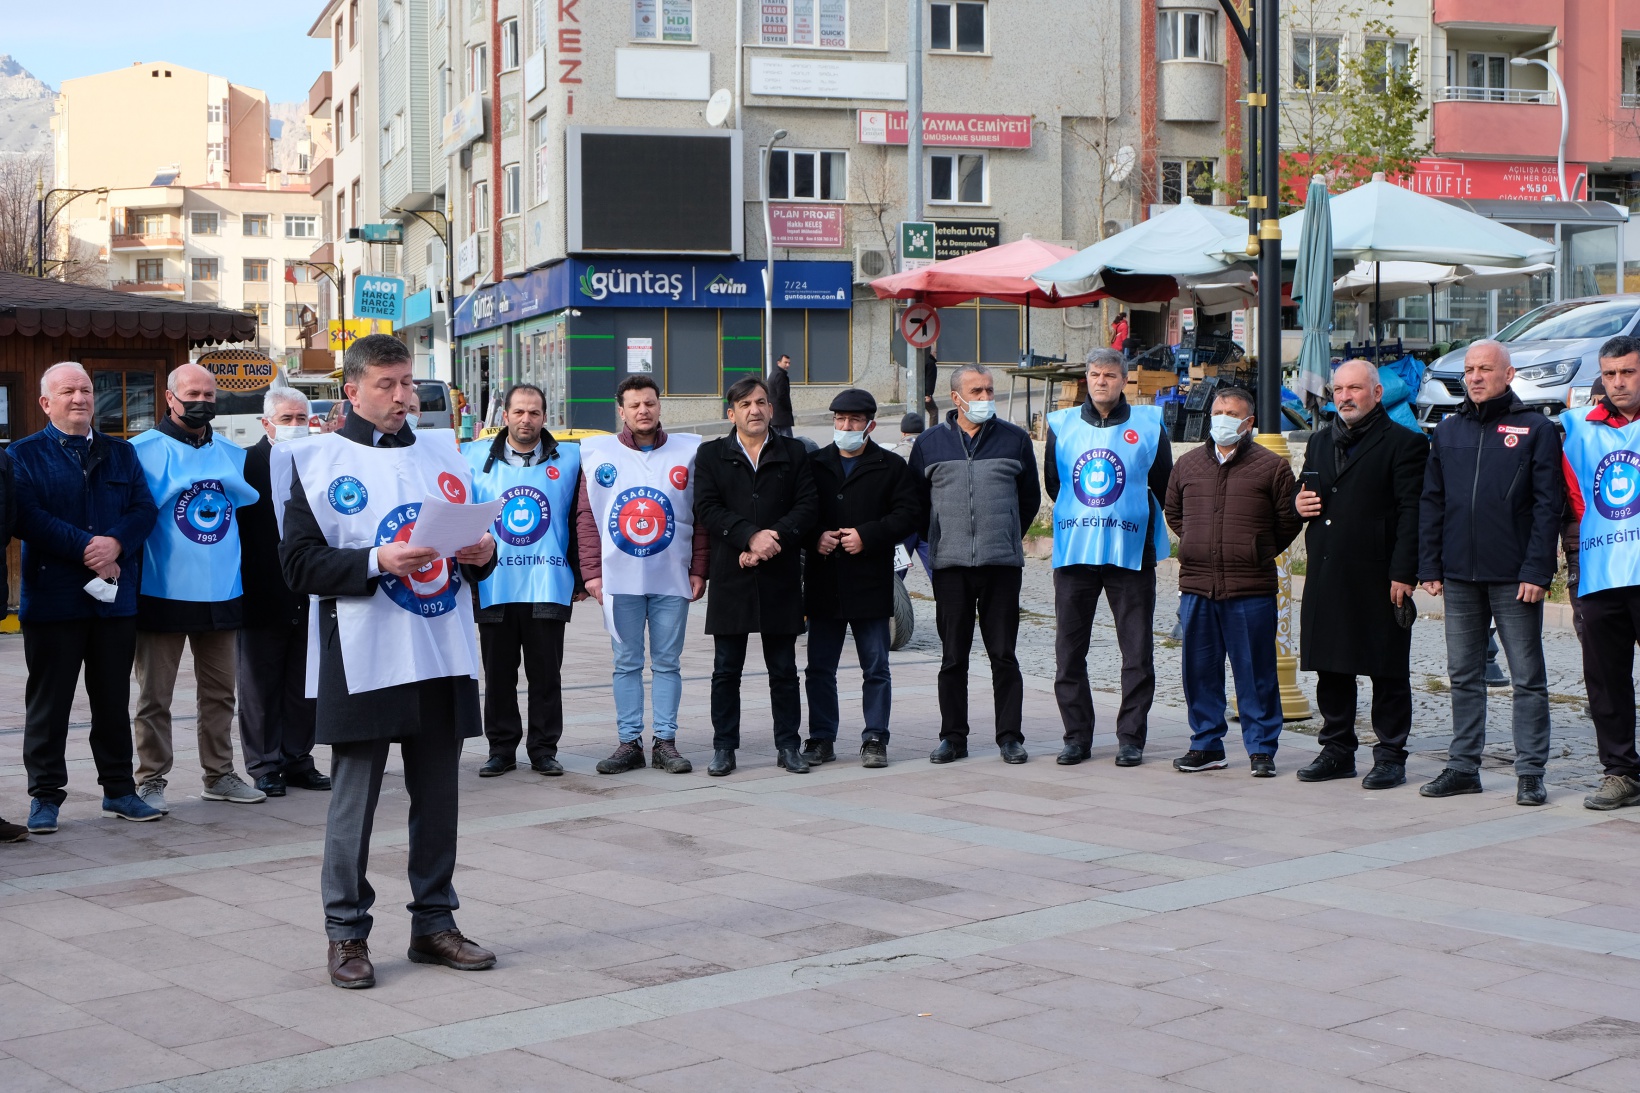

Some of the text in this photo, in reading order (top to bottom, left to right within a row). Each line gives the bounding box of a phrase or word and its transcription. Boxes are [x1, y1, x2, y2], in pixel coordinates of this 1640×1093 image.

[667, 16, 689, 25] HDI
[820, 38, 845, 46] ERGO
[922, 118, 964, 131] YAYMA
[968, 118, 1027, 132] CEMİYETİ
[970, 134, 999, 143] ŞUBESİ
[1509, 166, 1539, 174] AÇILIŞA
[1519, 184, 1547, 193] +%50
[773, 210, 836, 219] PLAN PROJE
[970, 227, 996, 238] UTUŞ
[949, 240, 988, 248] Danışmanlık
[591, 267, 683, 300] güntaş
[785, 281, 807, 289] 7/24
[362, 291, 395, 300] HARCA
[362, 298, 394, 308] HARCA
[331, 328, 358, 343] ŞOK
[202, 362, 272, 376] MURAT TAKSİ
[1074, 450, 1122, 484] TÜRK EĞİTİM-SEN
[1594, 467, 1604, 496] TÜRK
[176, 484, 200, 520] TÜRKİYE
[508, 487, 548, 520] EĞİTİM-SEN
[1610, 508, 1632, 518] 1992
[610, 503, 621, 537] TÜRK
[1058, 516, 1139, 533] TÜRK EĞİTİM-SEN
[198, 534, 217, 542] 1992
[1581, 536, 1604, 552] TÜRK
[507, 554, 568, 567] EĞİTİM-SEN
